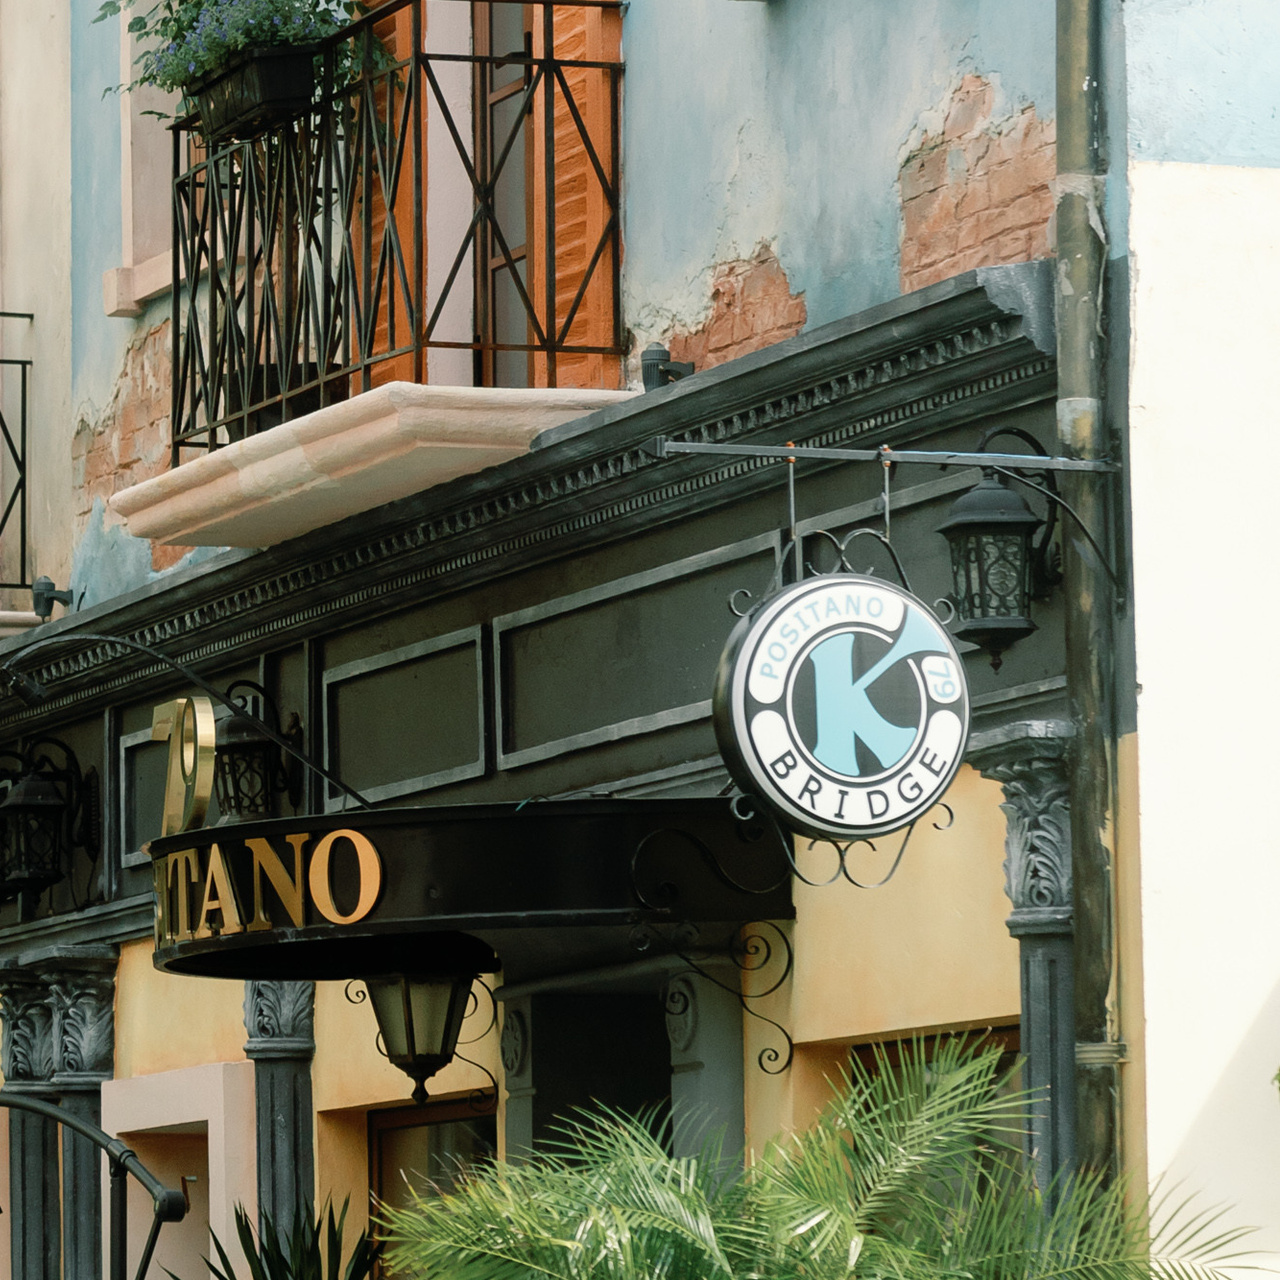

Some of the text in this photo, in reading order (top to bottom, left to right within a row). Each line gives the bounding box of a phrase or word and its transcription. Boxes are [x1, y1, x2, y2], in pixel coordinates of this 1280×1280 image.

[760, 594, 884, 680] POSITANO
[927, 660, 956, 698] 79
[770, 747, 948, 820] BRIDGE
